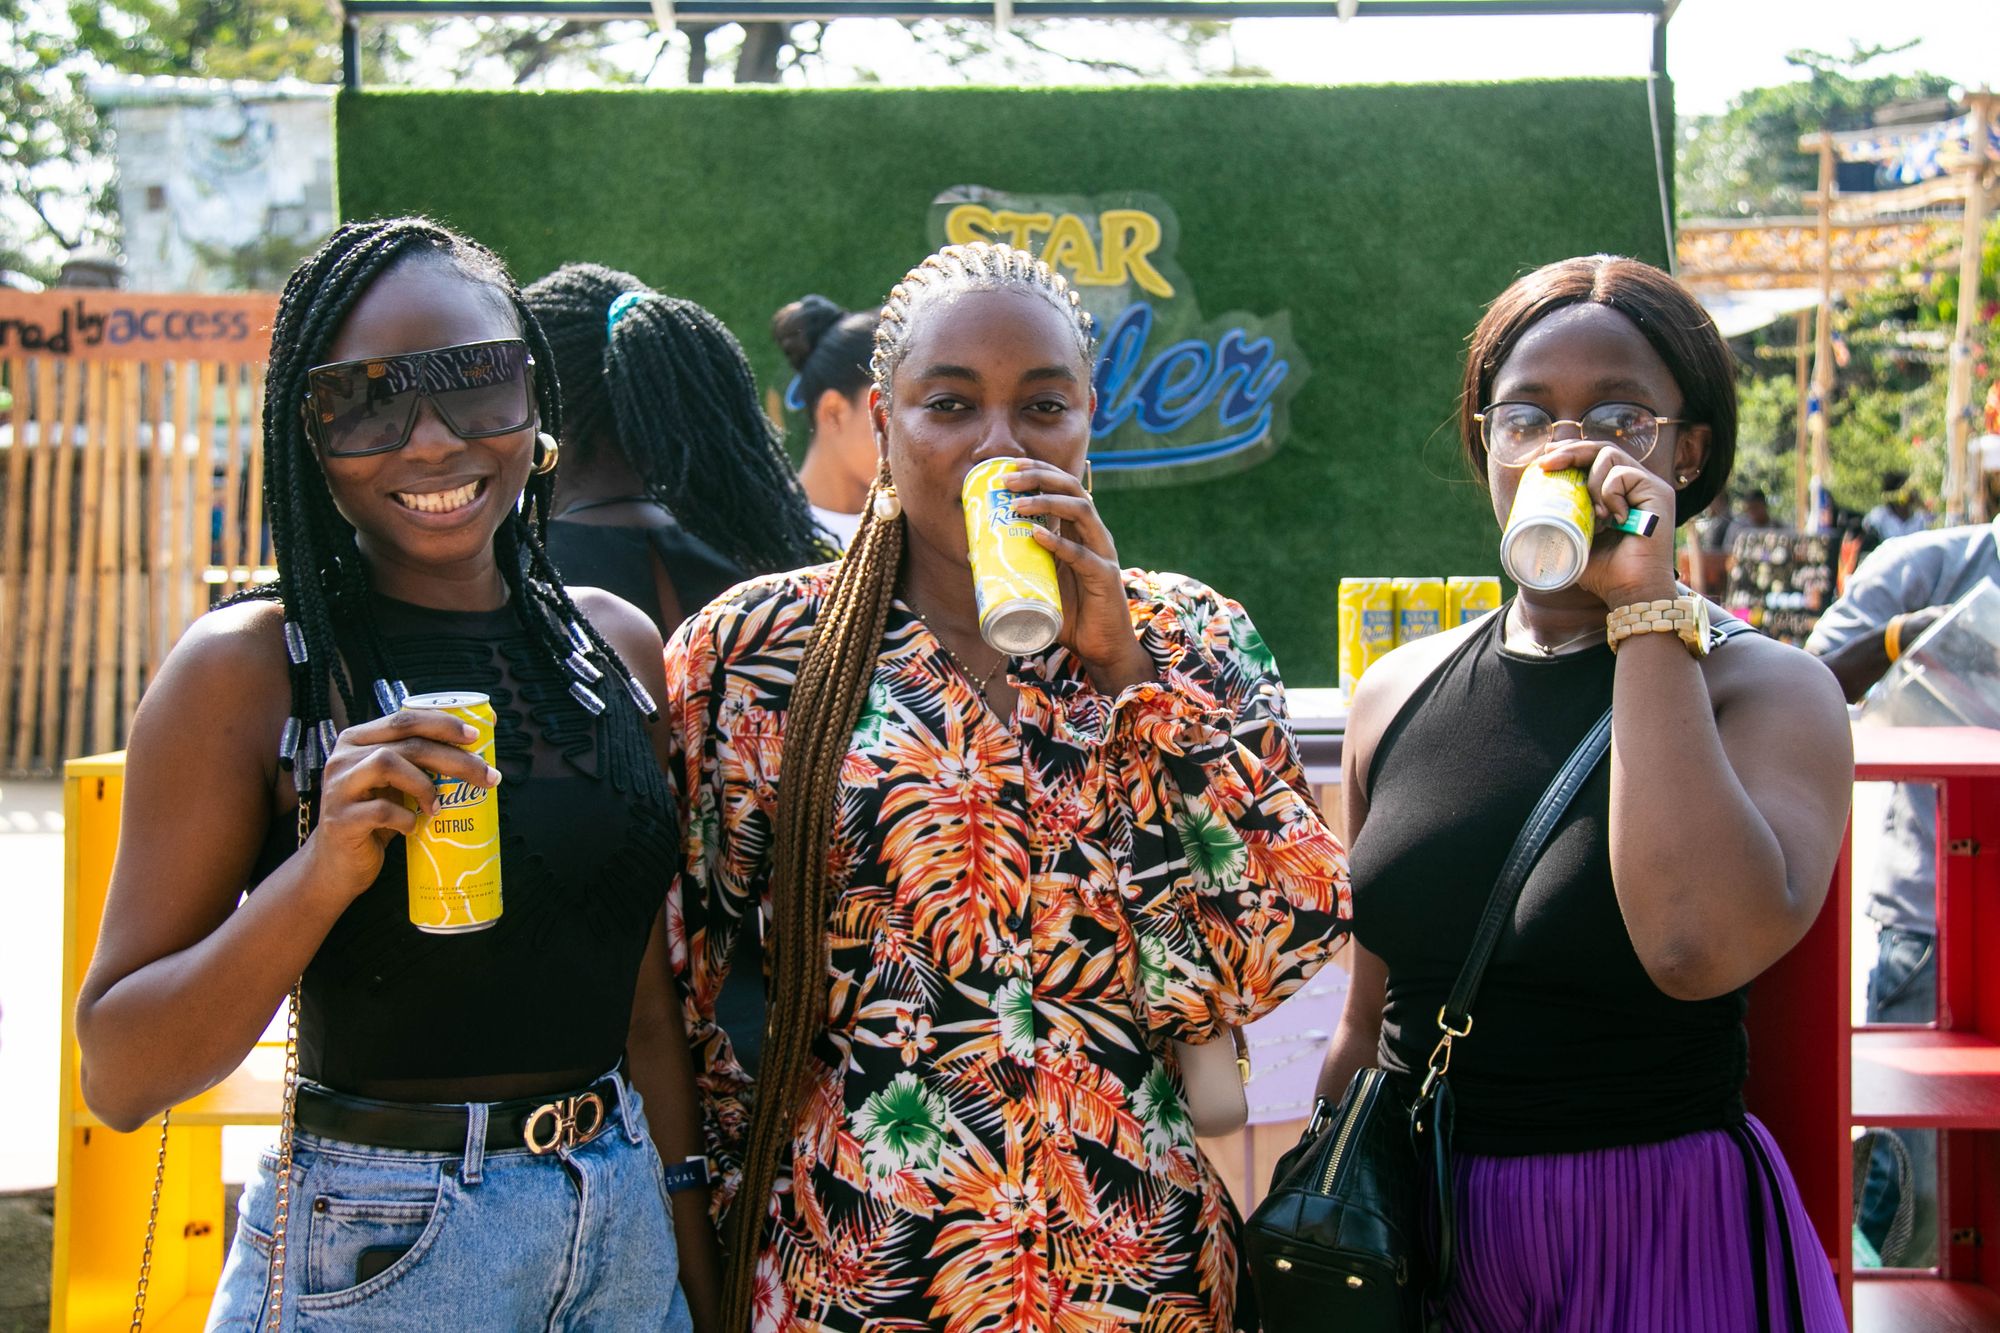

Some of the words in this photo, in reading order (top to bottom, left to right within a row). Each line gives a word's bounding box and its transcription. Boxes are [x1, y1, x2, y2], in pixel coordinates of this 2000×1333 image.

[945, 204, 1176, 298] STAR
[75, 298, 108, 346] by
[108, 308, 249, 346] access
[434, 818, 475, 834] CITRUS
